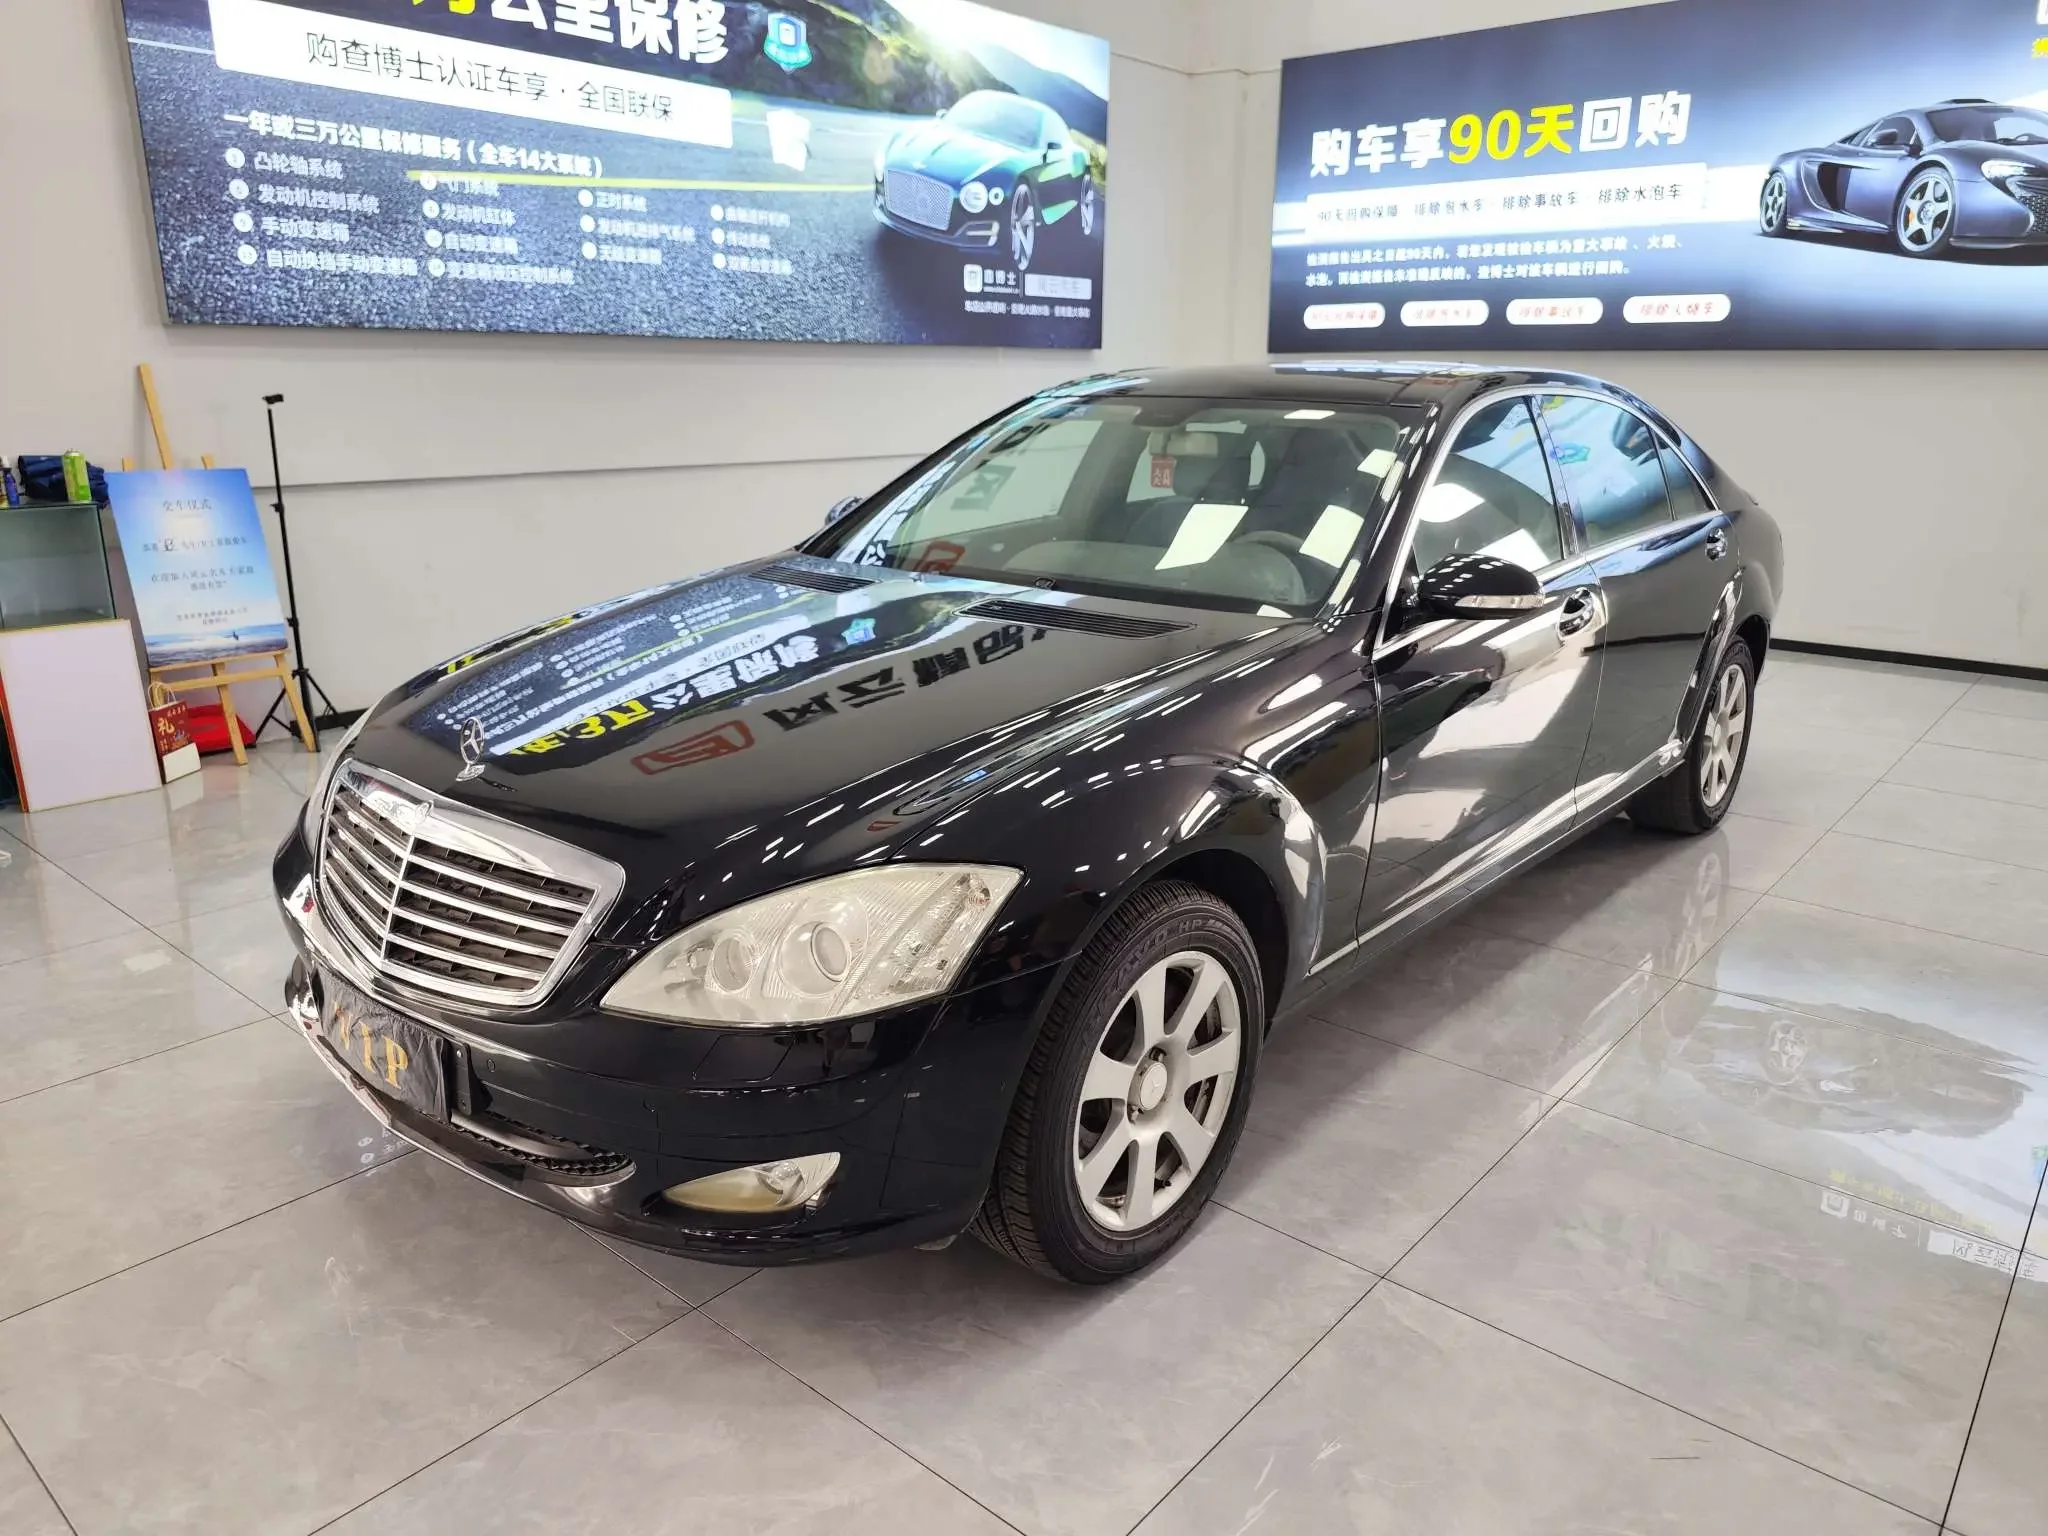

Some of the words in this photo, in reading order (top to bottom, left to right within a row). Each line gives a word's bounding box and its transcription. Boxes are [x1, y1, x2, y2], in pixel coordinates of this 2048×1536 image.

[1310, 90, 1692, 178] 购车享90天回购
